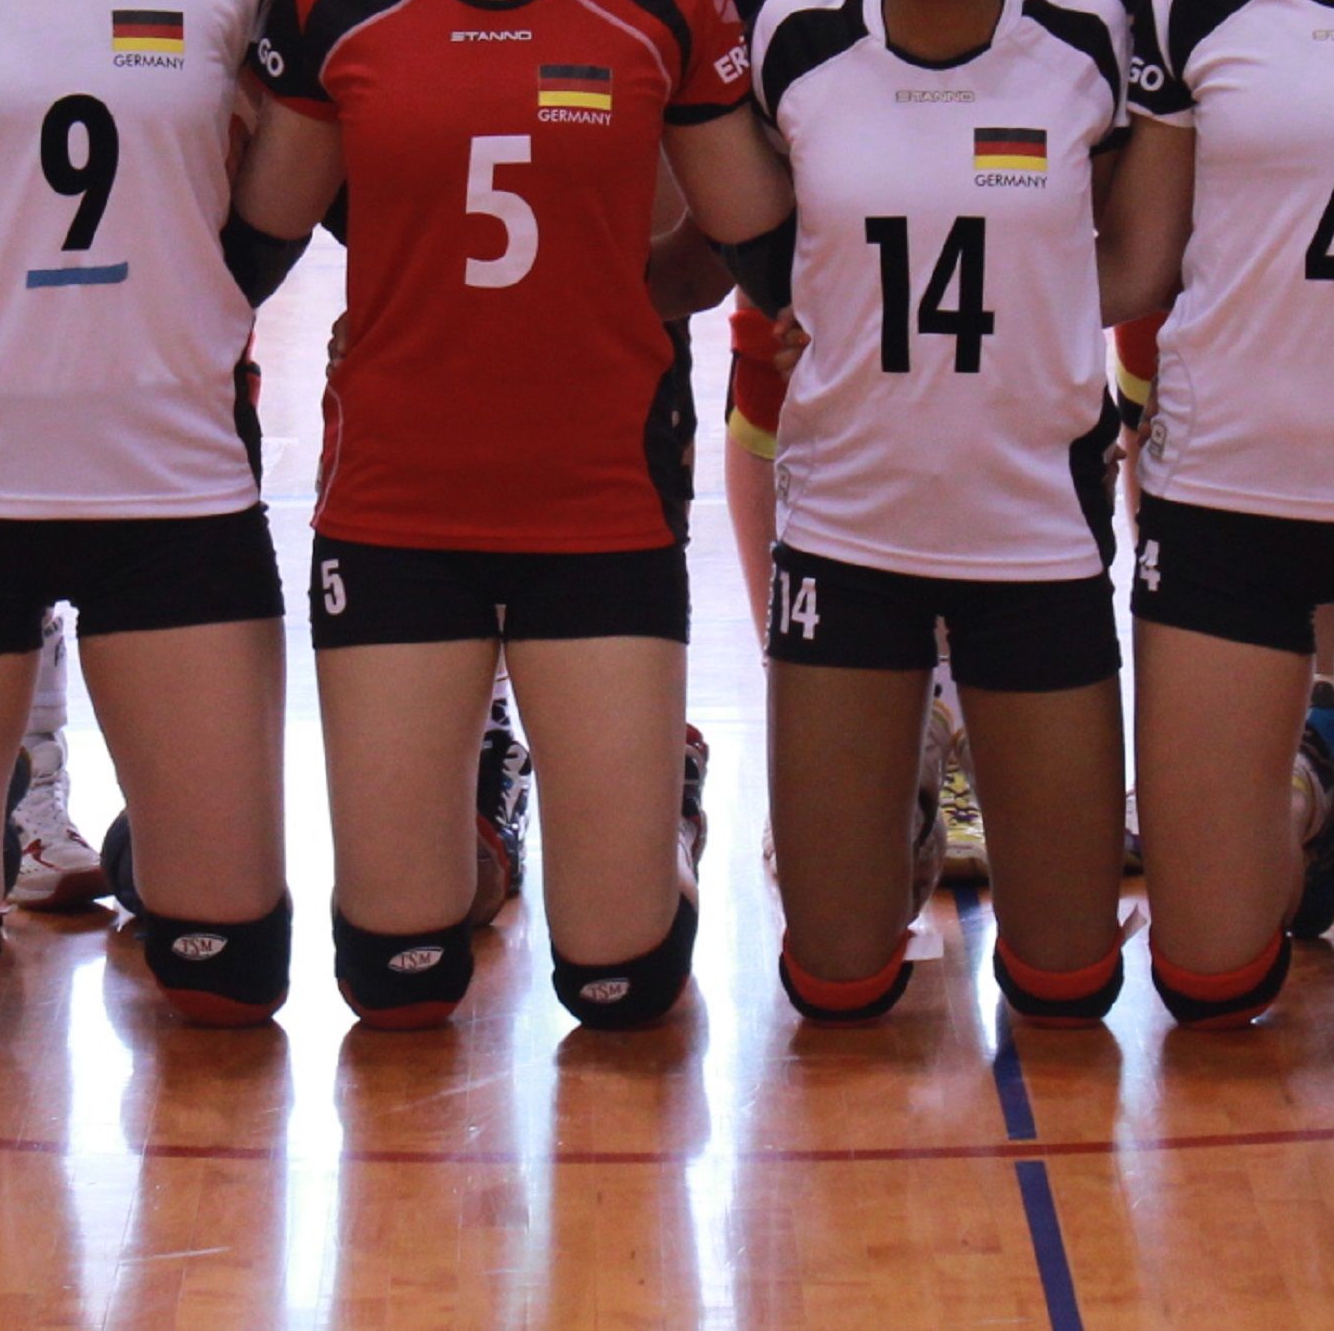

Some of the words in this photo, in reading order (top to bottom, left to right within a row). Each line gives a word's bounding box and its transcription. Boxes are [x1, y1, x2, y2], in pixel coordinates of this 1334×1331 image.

[450, 31, 532, 42] STANNO
[113, 53, 185, 70] GERMANY
[713, 38, 750, 84] ER
[537, 108, 612, 126] GERMANY
[896, 89, 975, 103] STANNO
[39, 93, 119, 251] 9
[974, 173, 1048, 189] GERMANY
[464, 134, 540, 289] 5
[865, 216, 995, 374] 14
[320, 558, 347, 616] 5
[779, 570, 820, 640] 14
